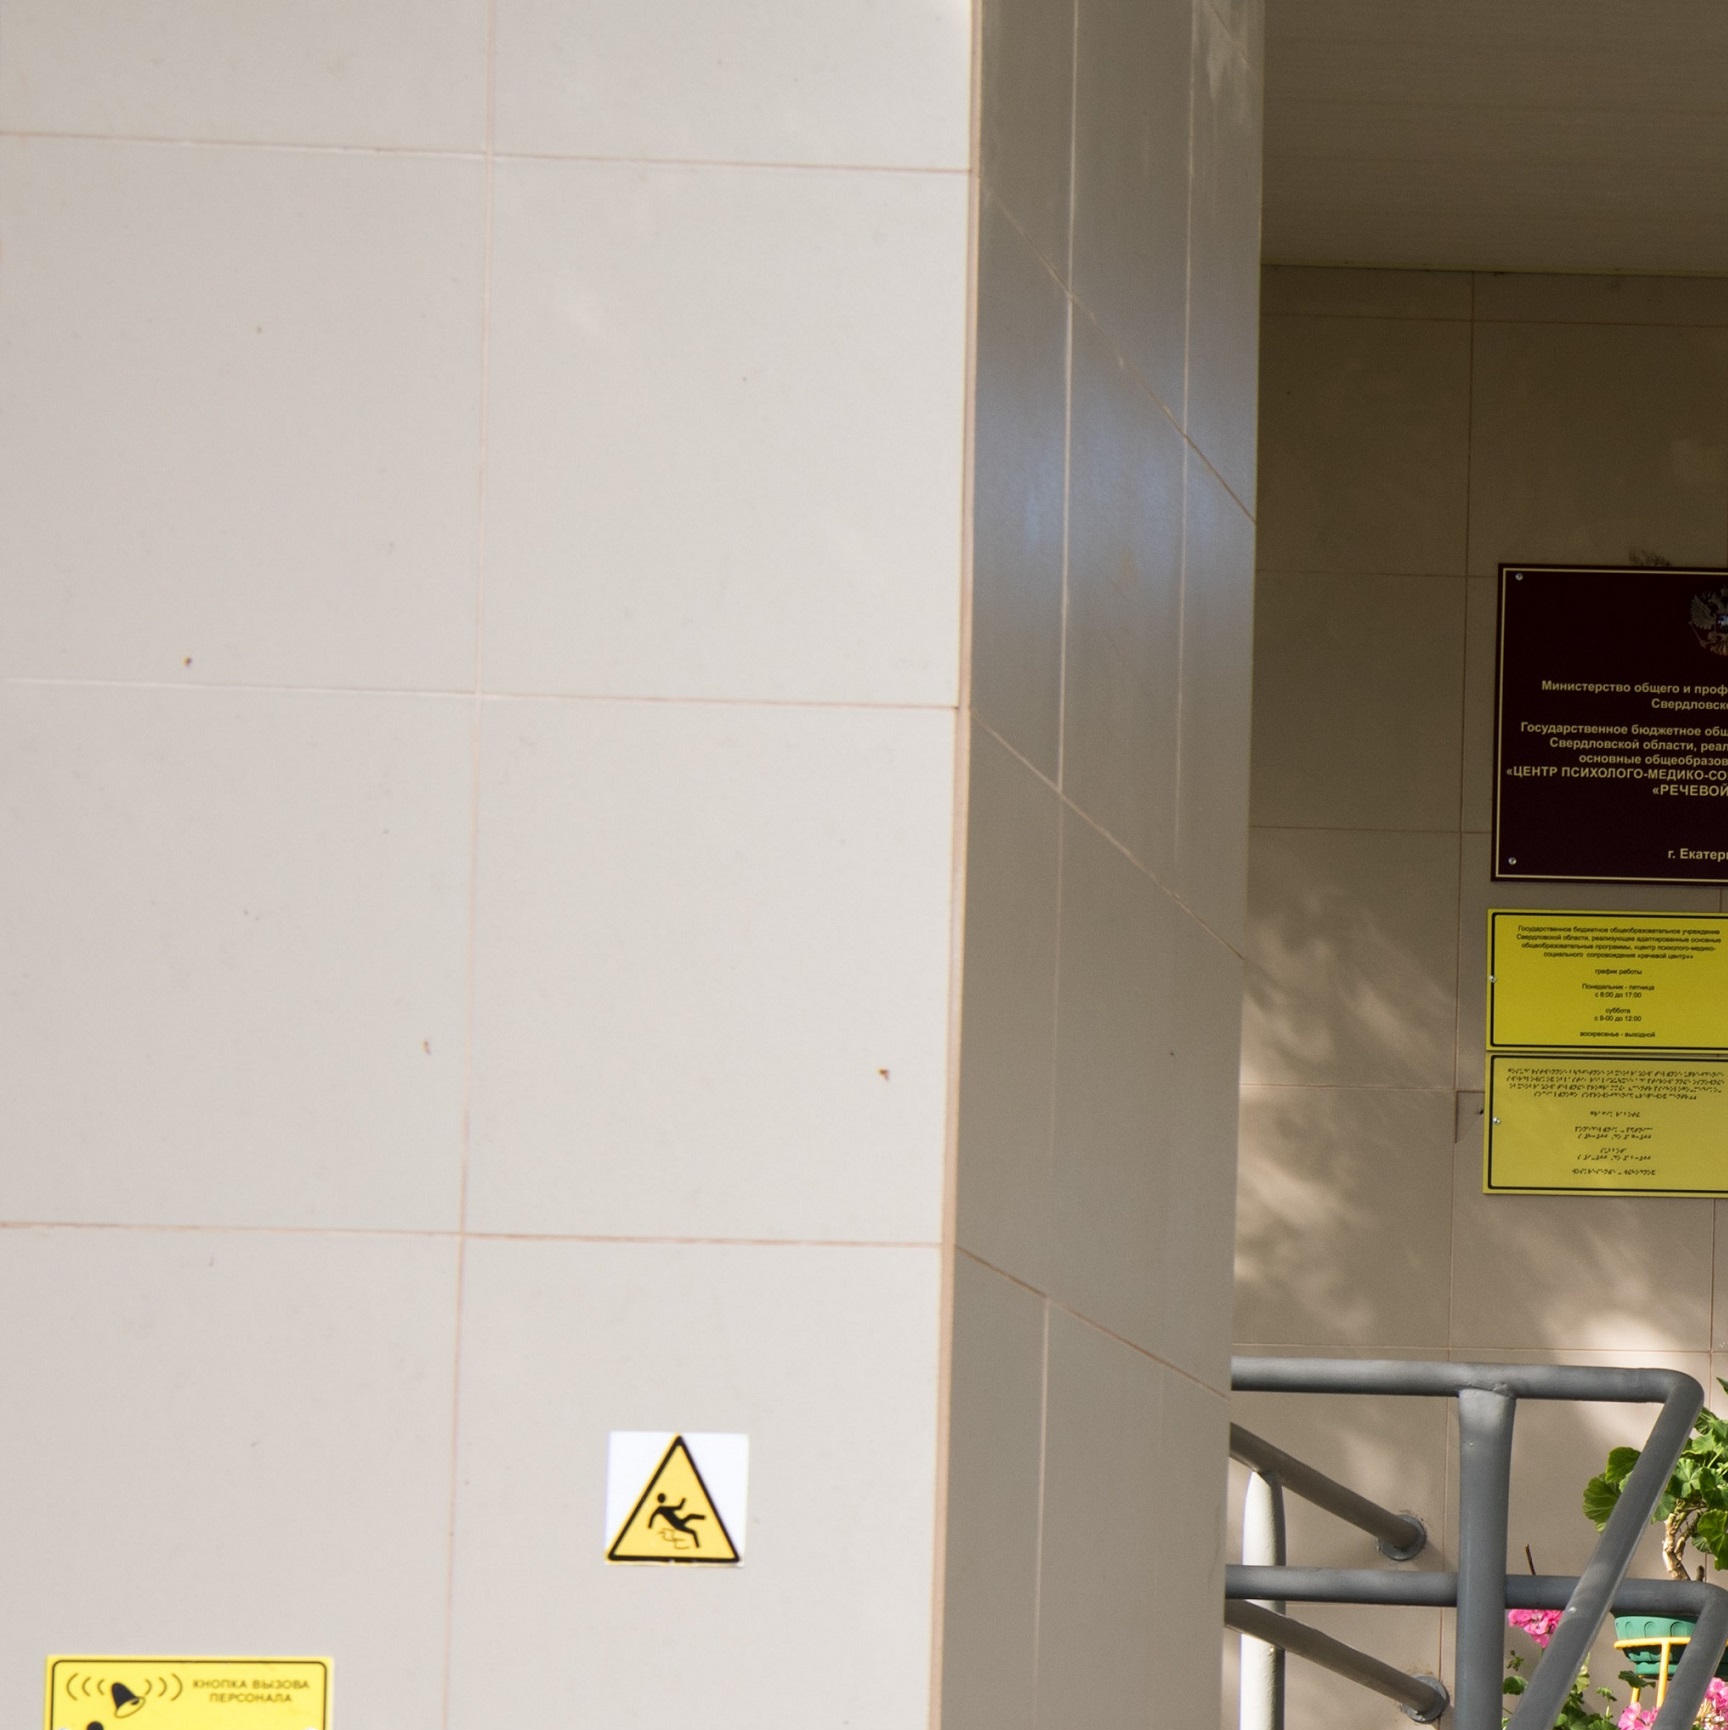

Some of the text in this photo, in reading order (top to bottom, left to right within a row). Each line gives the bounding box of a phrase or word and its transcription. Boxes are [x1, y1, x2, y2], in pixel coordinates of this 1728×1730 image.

[1542, 680, 1631, 693] Министерство
[1634, 683, 1679, 694] общего
[1521, 722, 1627, 735] Государственное
[1631, 725, 1701, 736] бюджетное
[1550, 737, 1639, 750] Свердловской
[1643, 740, 1697, 752] области,
[1579, 755, 1641, 764] основные
[1507, 766, 1557, 777] «ЦЕНТР
[1652, 783, 1728, 796] «РЕЧЕВОЙ
[1668, 850, 1675, 859] г.
[192, 1680, 309, 1689] КНОПКА ВЫЗОВА
[210, 1693, 292, 1703] ПЕРСОНАЛА
